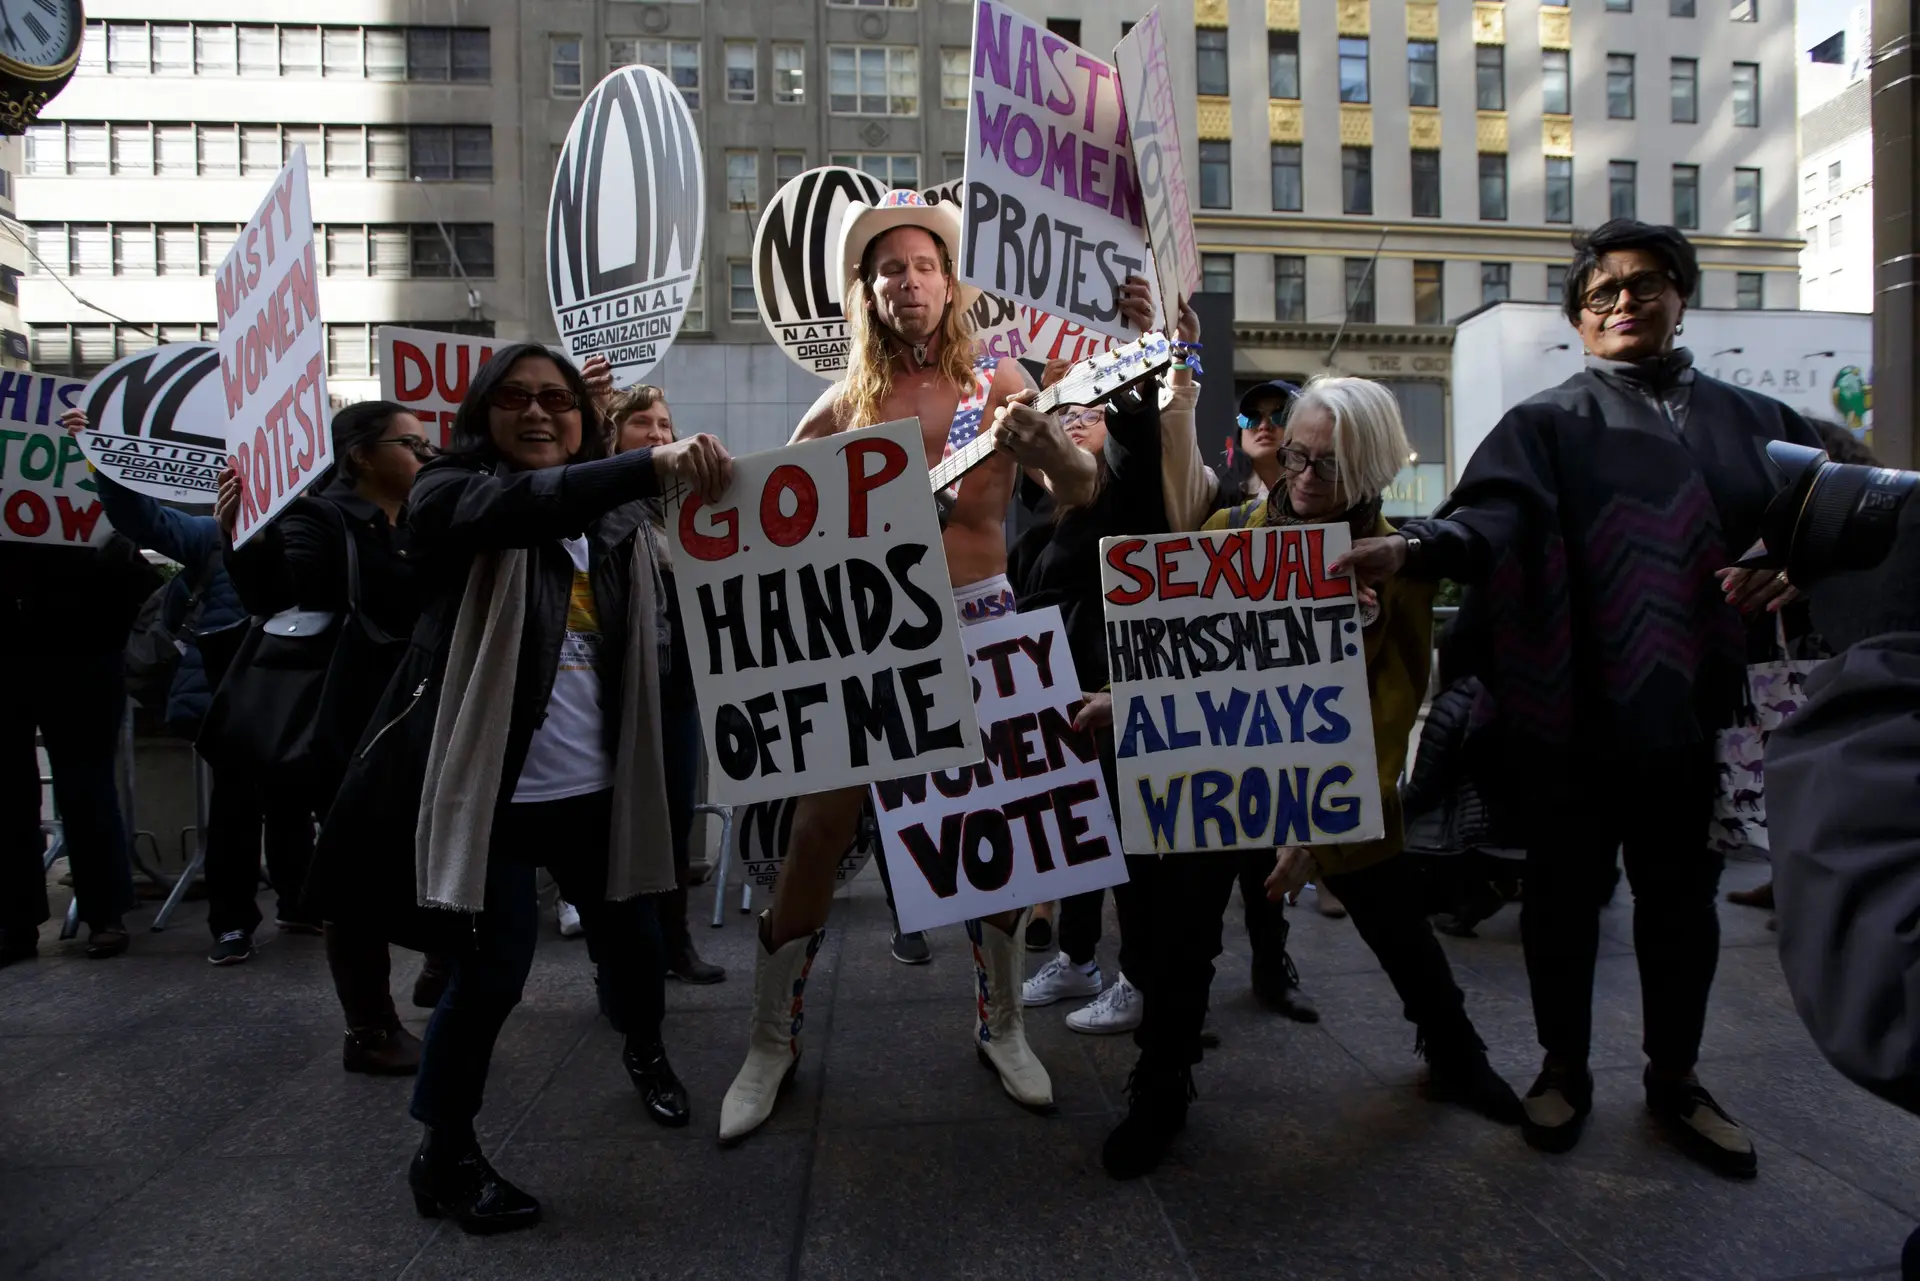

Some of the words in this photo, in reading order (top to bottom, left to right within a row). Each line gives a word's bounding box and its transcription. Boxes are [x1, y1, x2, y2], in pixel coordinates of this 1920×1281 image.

[975, 1, 1129, 148] NASTY
[550, 67, 698, 307] NOW
[975, 91, 1142, 228] WOMEN
[215, 168, 294, 333] NASTY
[966, 182, 1142, 329] PROTEST
[222, 240, 317, 420] WOMEN
[562, 286, 684, 331] NATIONAL
[572, 315, 672, 351] ORGANIZATION
[608, 342, 656, 363] WOMEN
[101, 453, 219, 479] ORGANIZAT
[120, 468, 157, 480] FOR
[163, 475, 220, 489] WOME
[227, 351, 326, 542] PROTEST
[0, 488, 102, 542] OW
[696, 543, 943, 675] HANDS
[1104, 528, 1353, 606] SEXUAL
[1106, 603, 1358, 682] HARASSMENT:
[715, 681, 829, 781] OFF
[841, 658, 965, 768] ME
[1117, 683, 1351, 758] ALWAYS
[897, 779, 1112, 899] VOTE
[1137, 763, 1361, 850] WRONG
